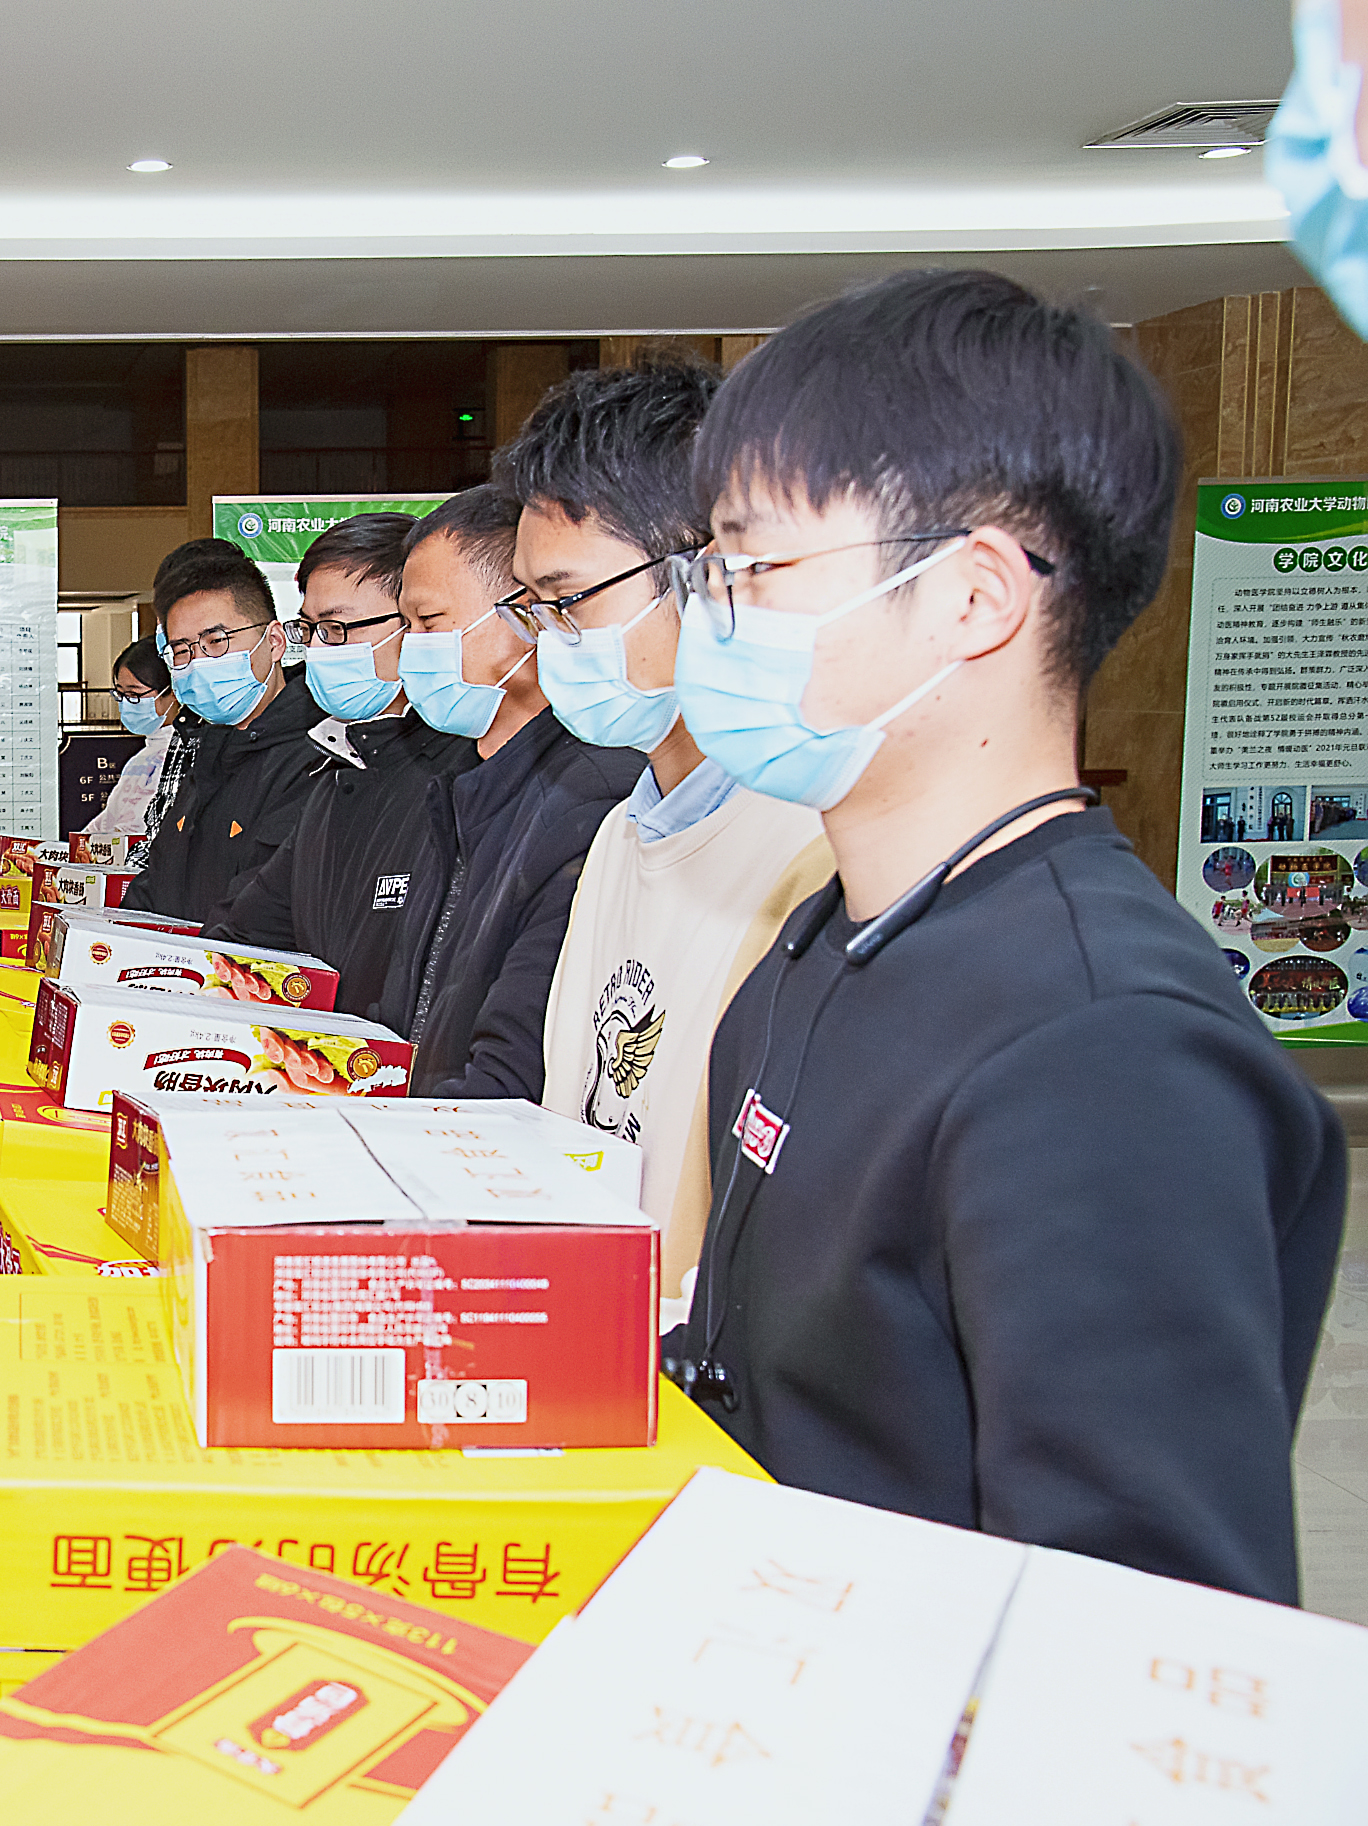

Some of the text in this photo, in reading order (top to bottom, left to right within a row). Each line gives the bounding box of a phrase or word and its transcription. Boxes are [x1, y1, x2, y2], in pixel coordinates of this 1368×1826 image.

[1250, 496, 1368, 513] 河南农业大学动物
[267, 518, 349, 532] 河南农业大
[1278, 551, 1368, 568] 学院文化
[79, 776, 93, 784] 6F
[81, 793, 94, 802] 5F
[624, 959, 655, 1005] RIDER
